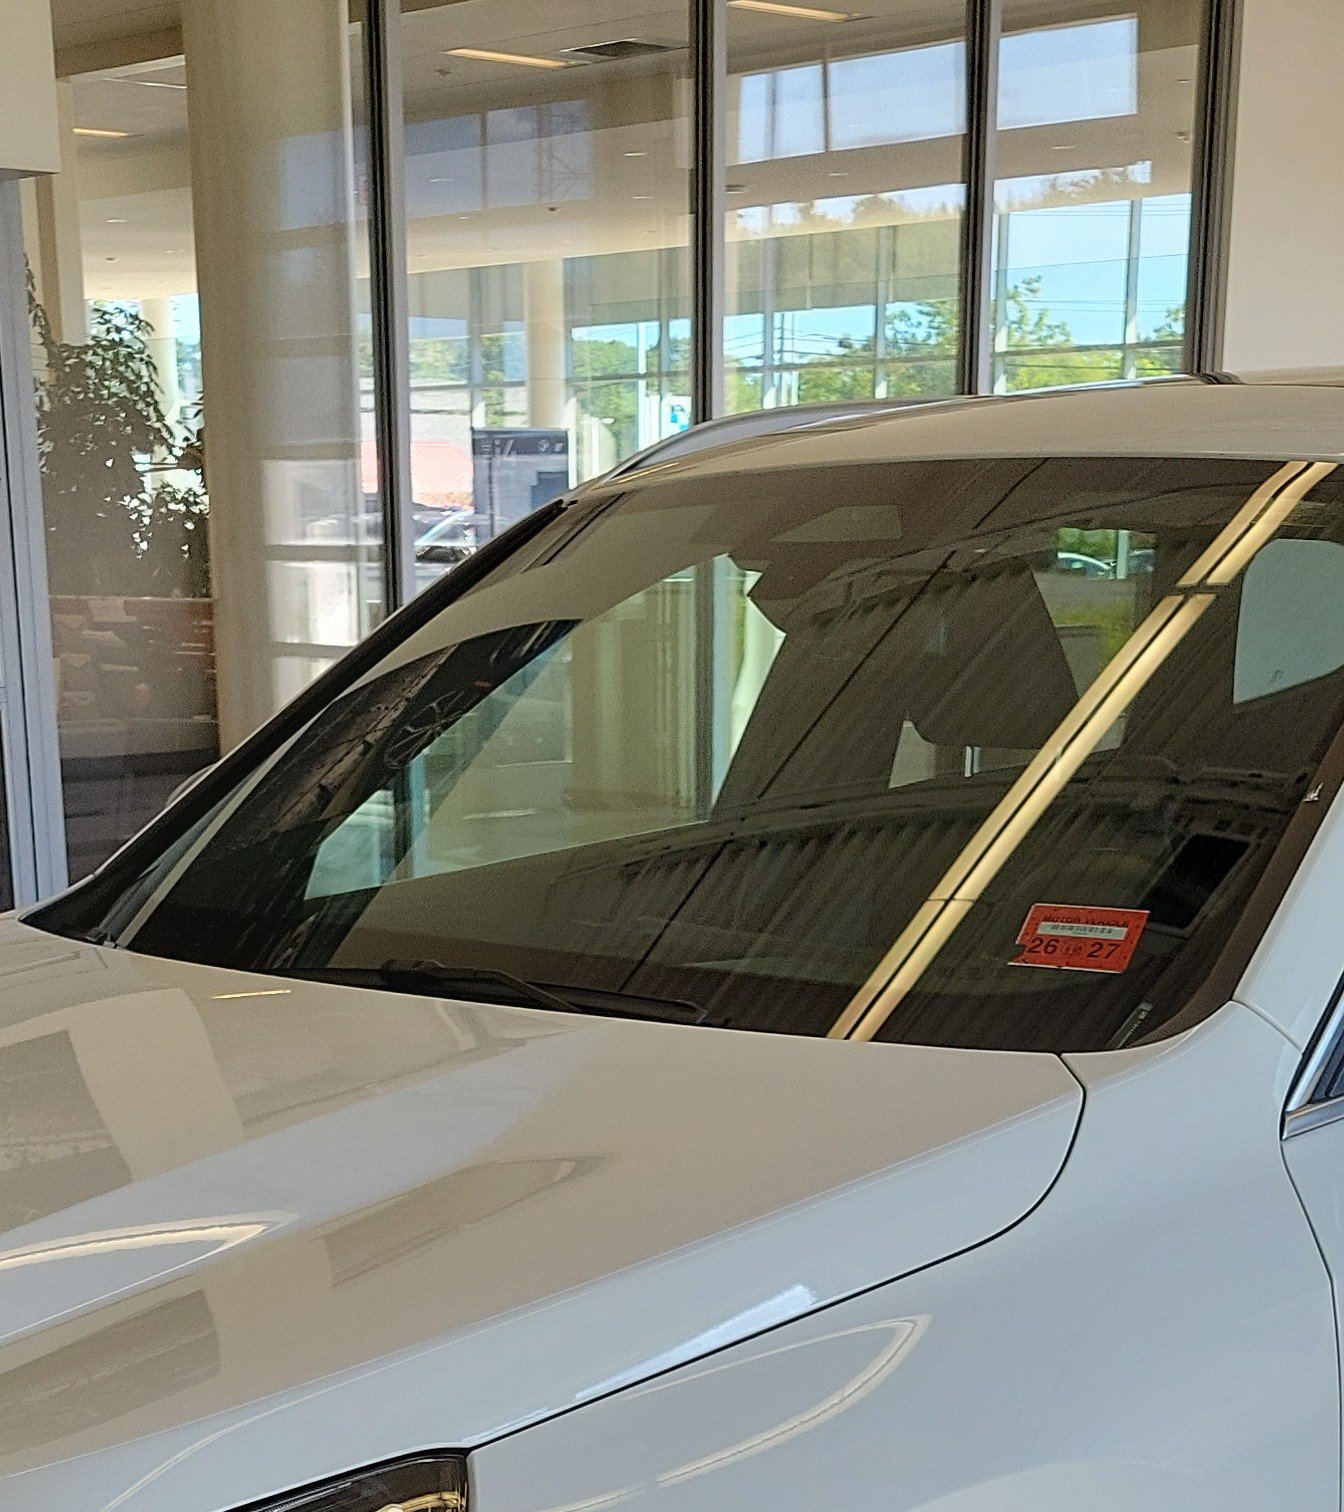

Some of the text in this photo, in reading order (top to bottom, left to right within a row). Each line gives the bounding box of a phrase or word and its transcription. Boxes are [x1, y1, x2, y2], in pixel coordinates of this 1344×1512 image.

[1043, 915, 1129, 928] MOTOR VEHICLE
[1027, 937, 1060, 955] 26
[1086, 941, 1121, 960] 27
